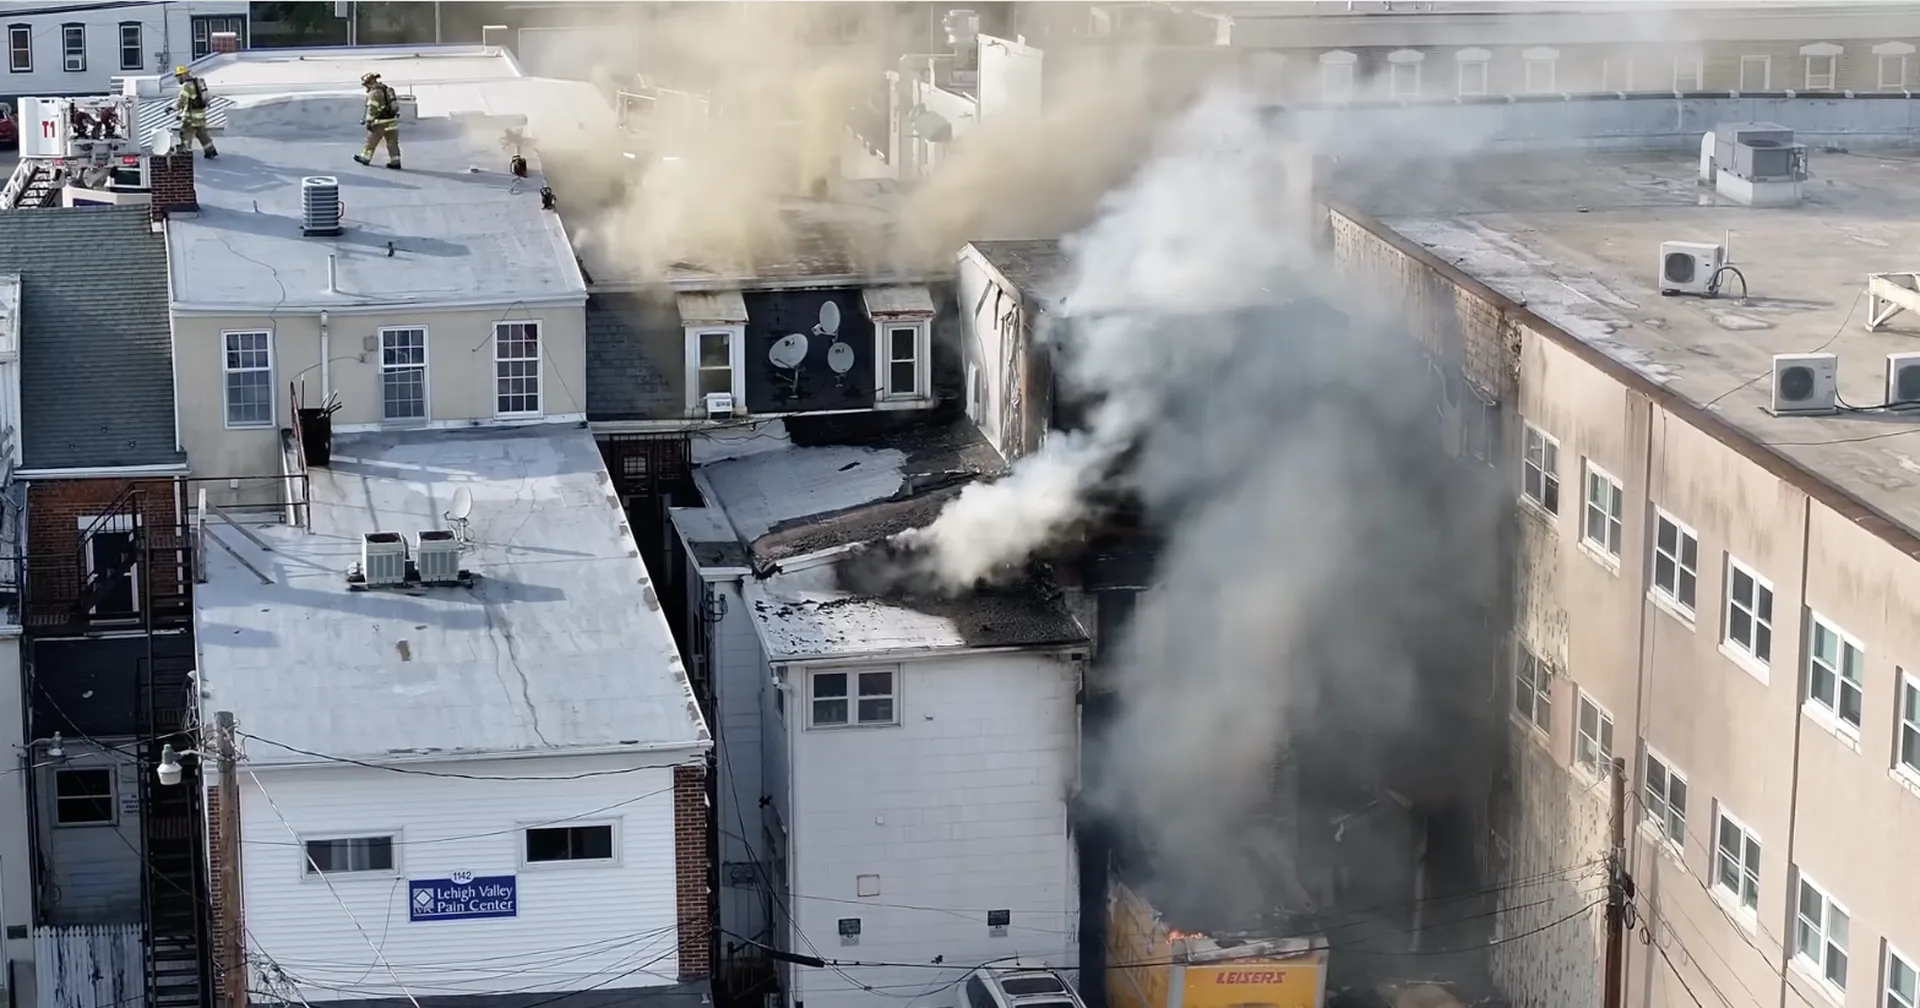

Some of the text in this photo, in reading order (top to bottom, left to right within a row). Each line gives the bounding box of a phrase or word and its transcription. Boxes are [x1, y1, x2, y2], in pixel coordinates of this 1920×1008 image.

[42, 120, 55, 138] T1
[453, 871, 472, 881] 1142
[437, 884, 513, 902] Lehigh Valley
[437, 899, 513, 912] Pain Center
